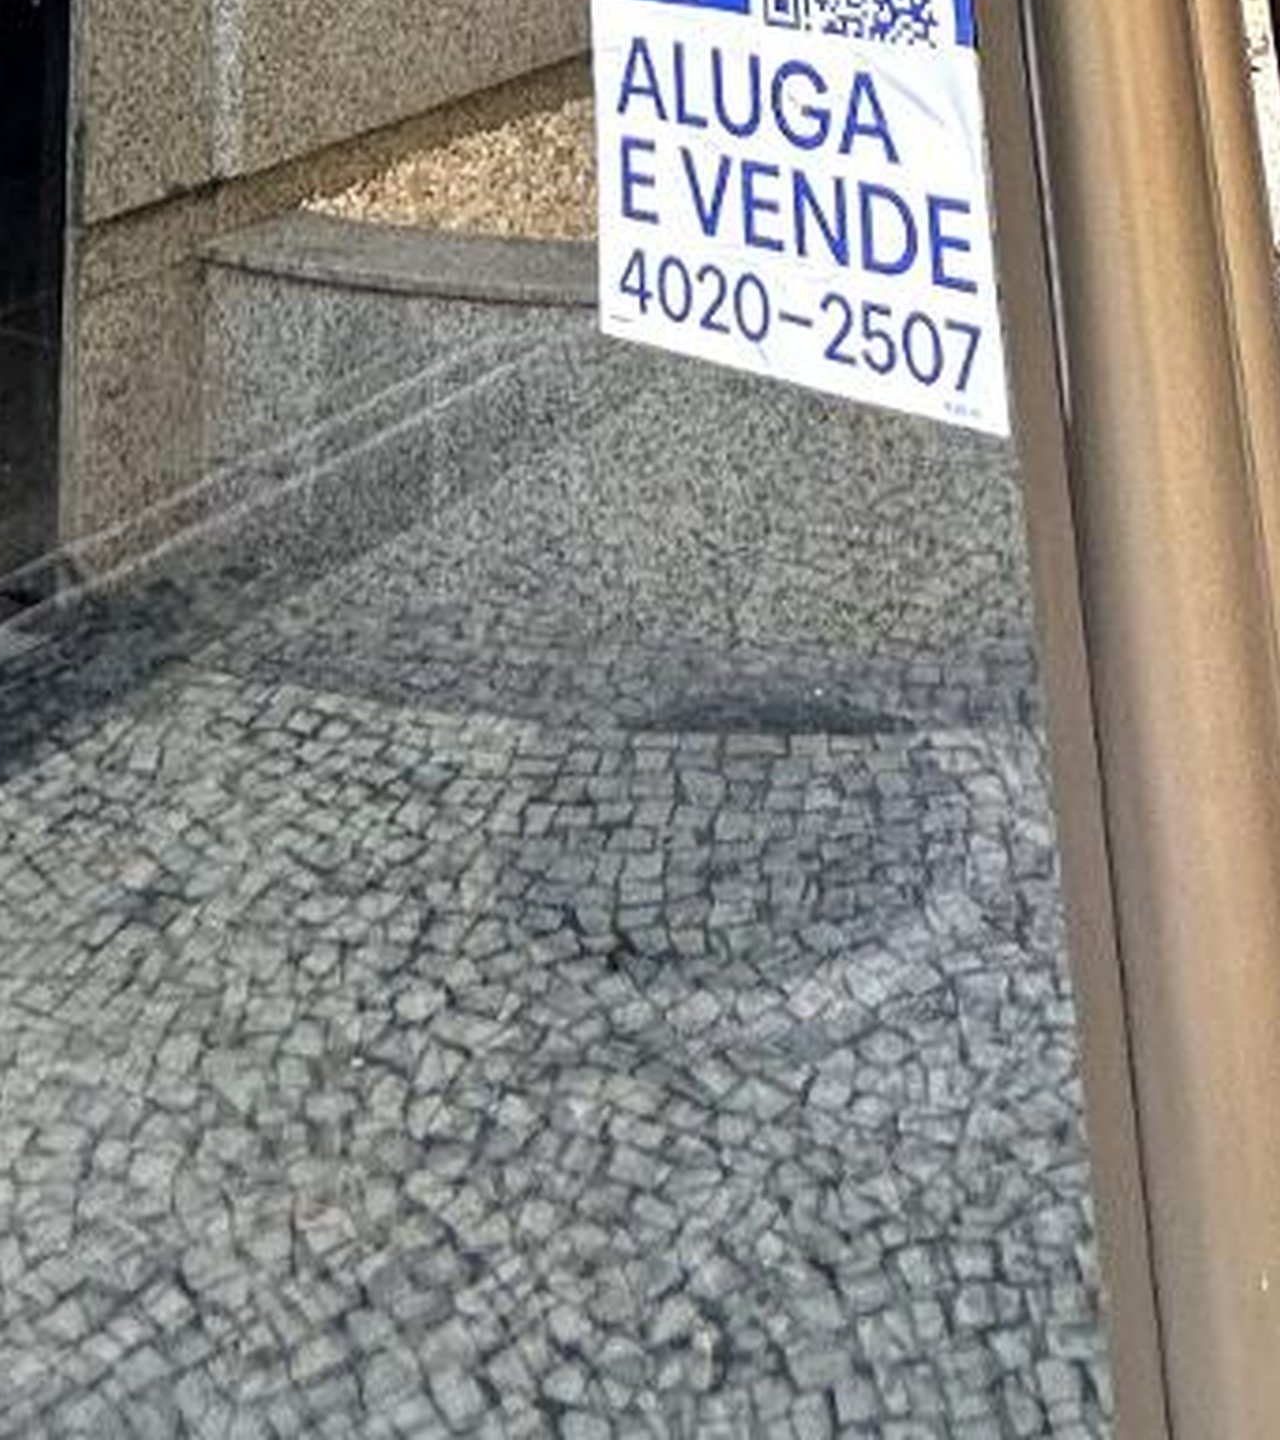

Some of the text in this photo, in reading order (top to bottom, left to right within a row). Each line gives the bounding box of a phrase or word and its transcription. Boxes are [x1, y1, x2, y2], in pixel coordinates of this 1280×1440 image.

[616, 36, 901, 166] ALUGA
[620, 135, 979, 296] E VENDE
[619, 247, 984, 393] 4020-2507
